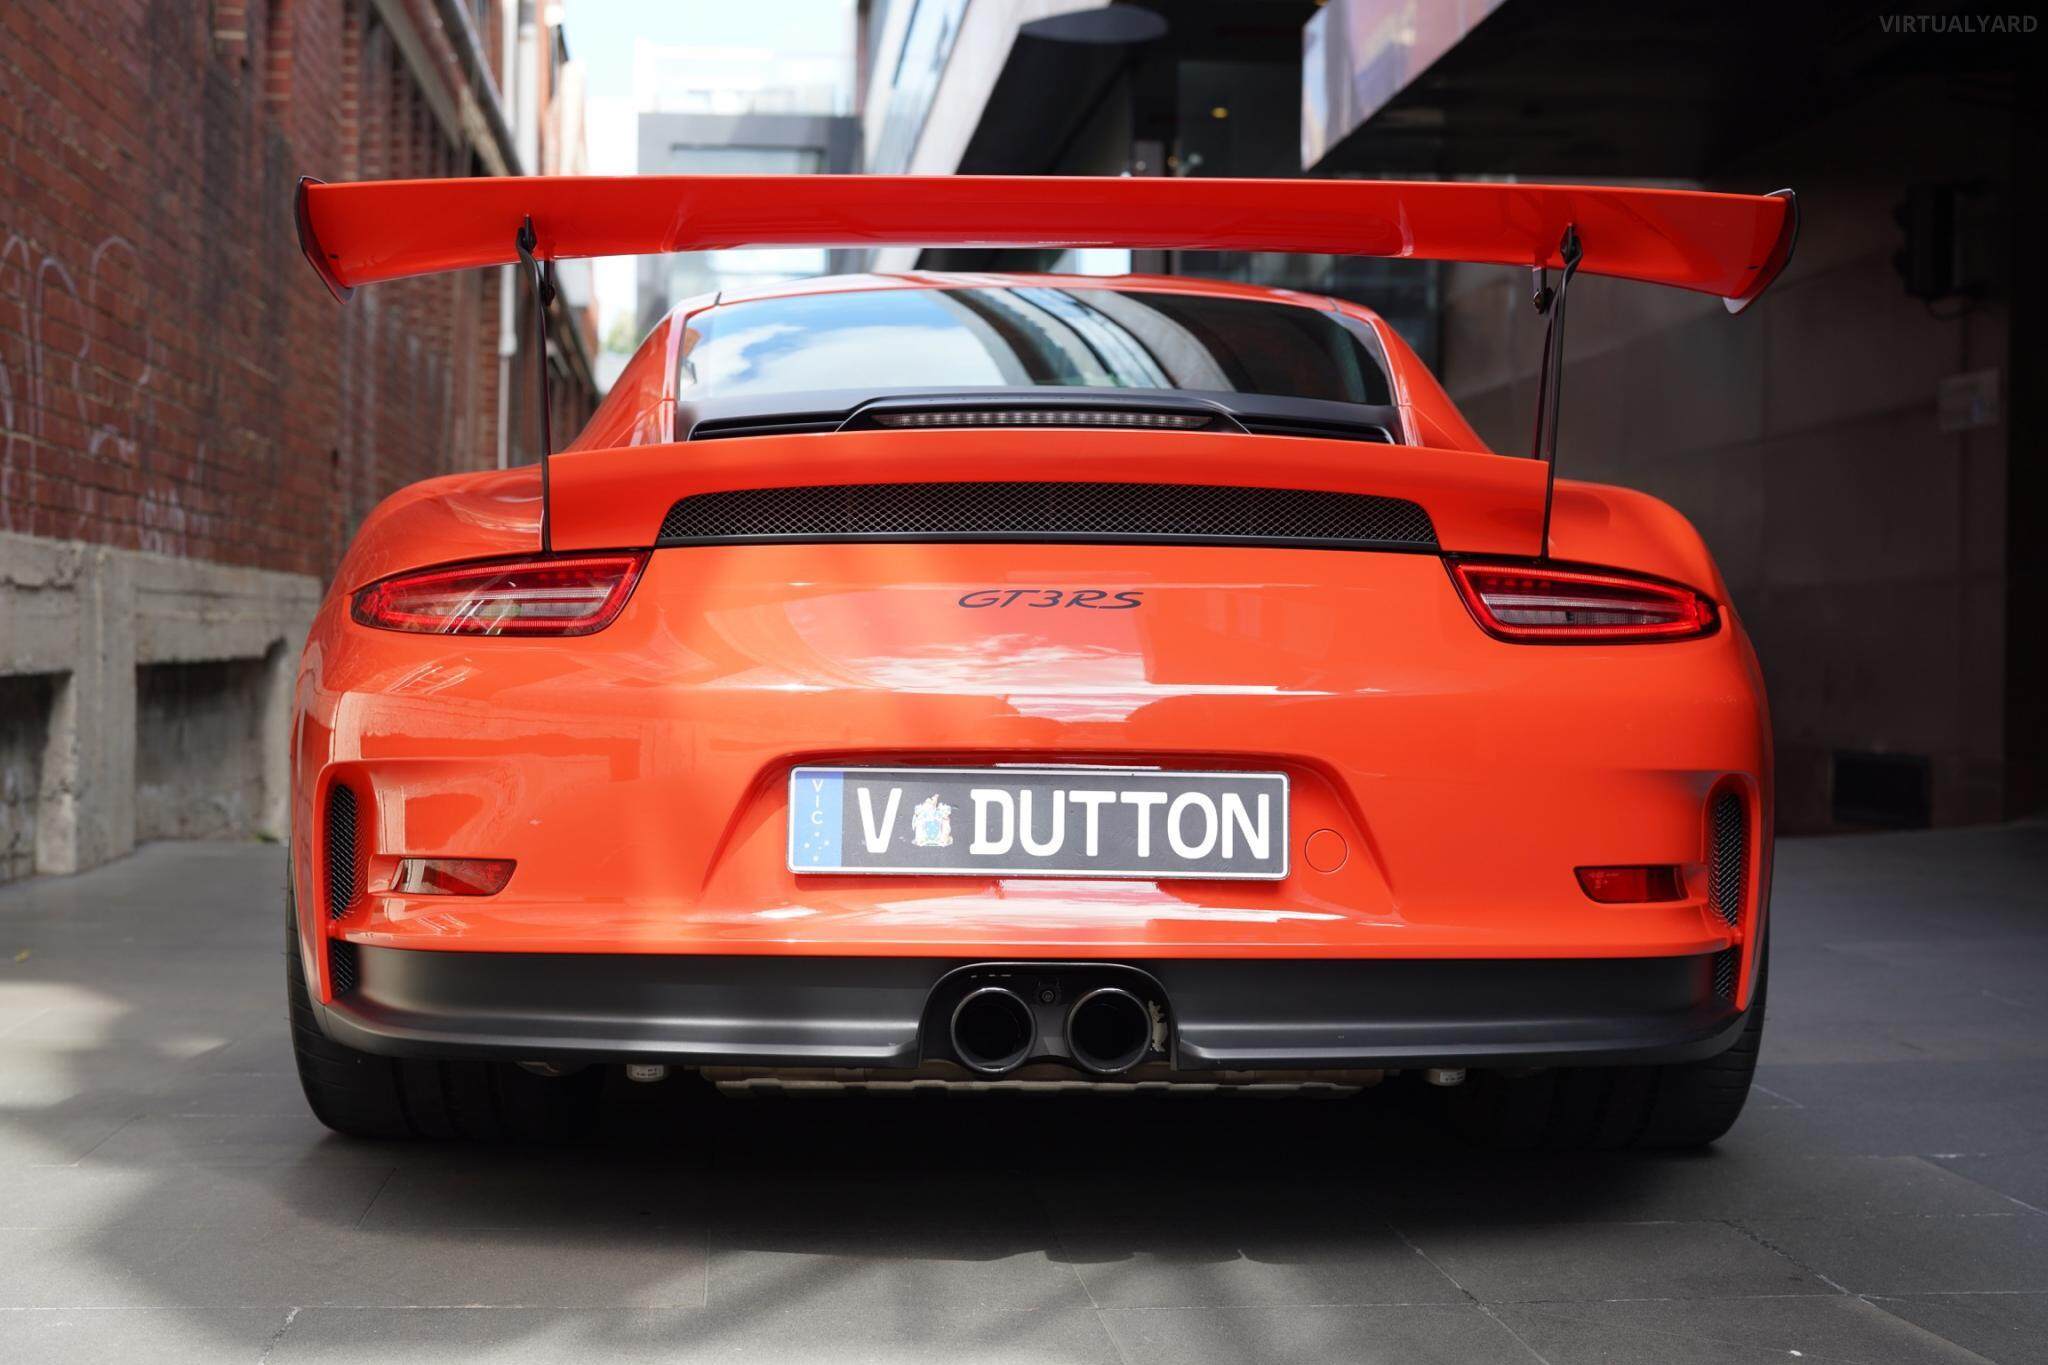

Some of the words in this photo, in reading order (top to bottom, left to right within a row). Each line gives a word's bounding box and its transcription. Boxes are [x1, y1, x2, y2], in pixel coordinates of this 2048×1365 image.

[811, 779, 824, 825] VIC
[857, 787, 903, 853] V
[969, 788, 1270, 859] DUTTON
